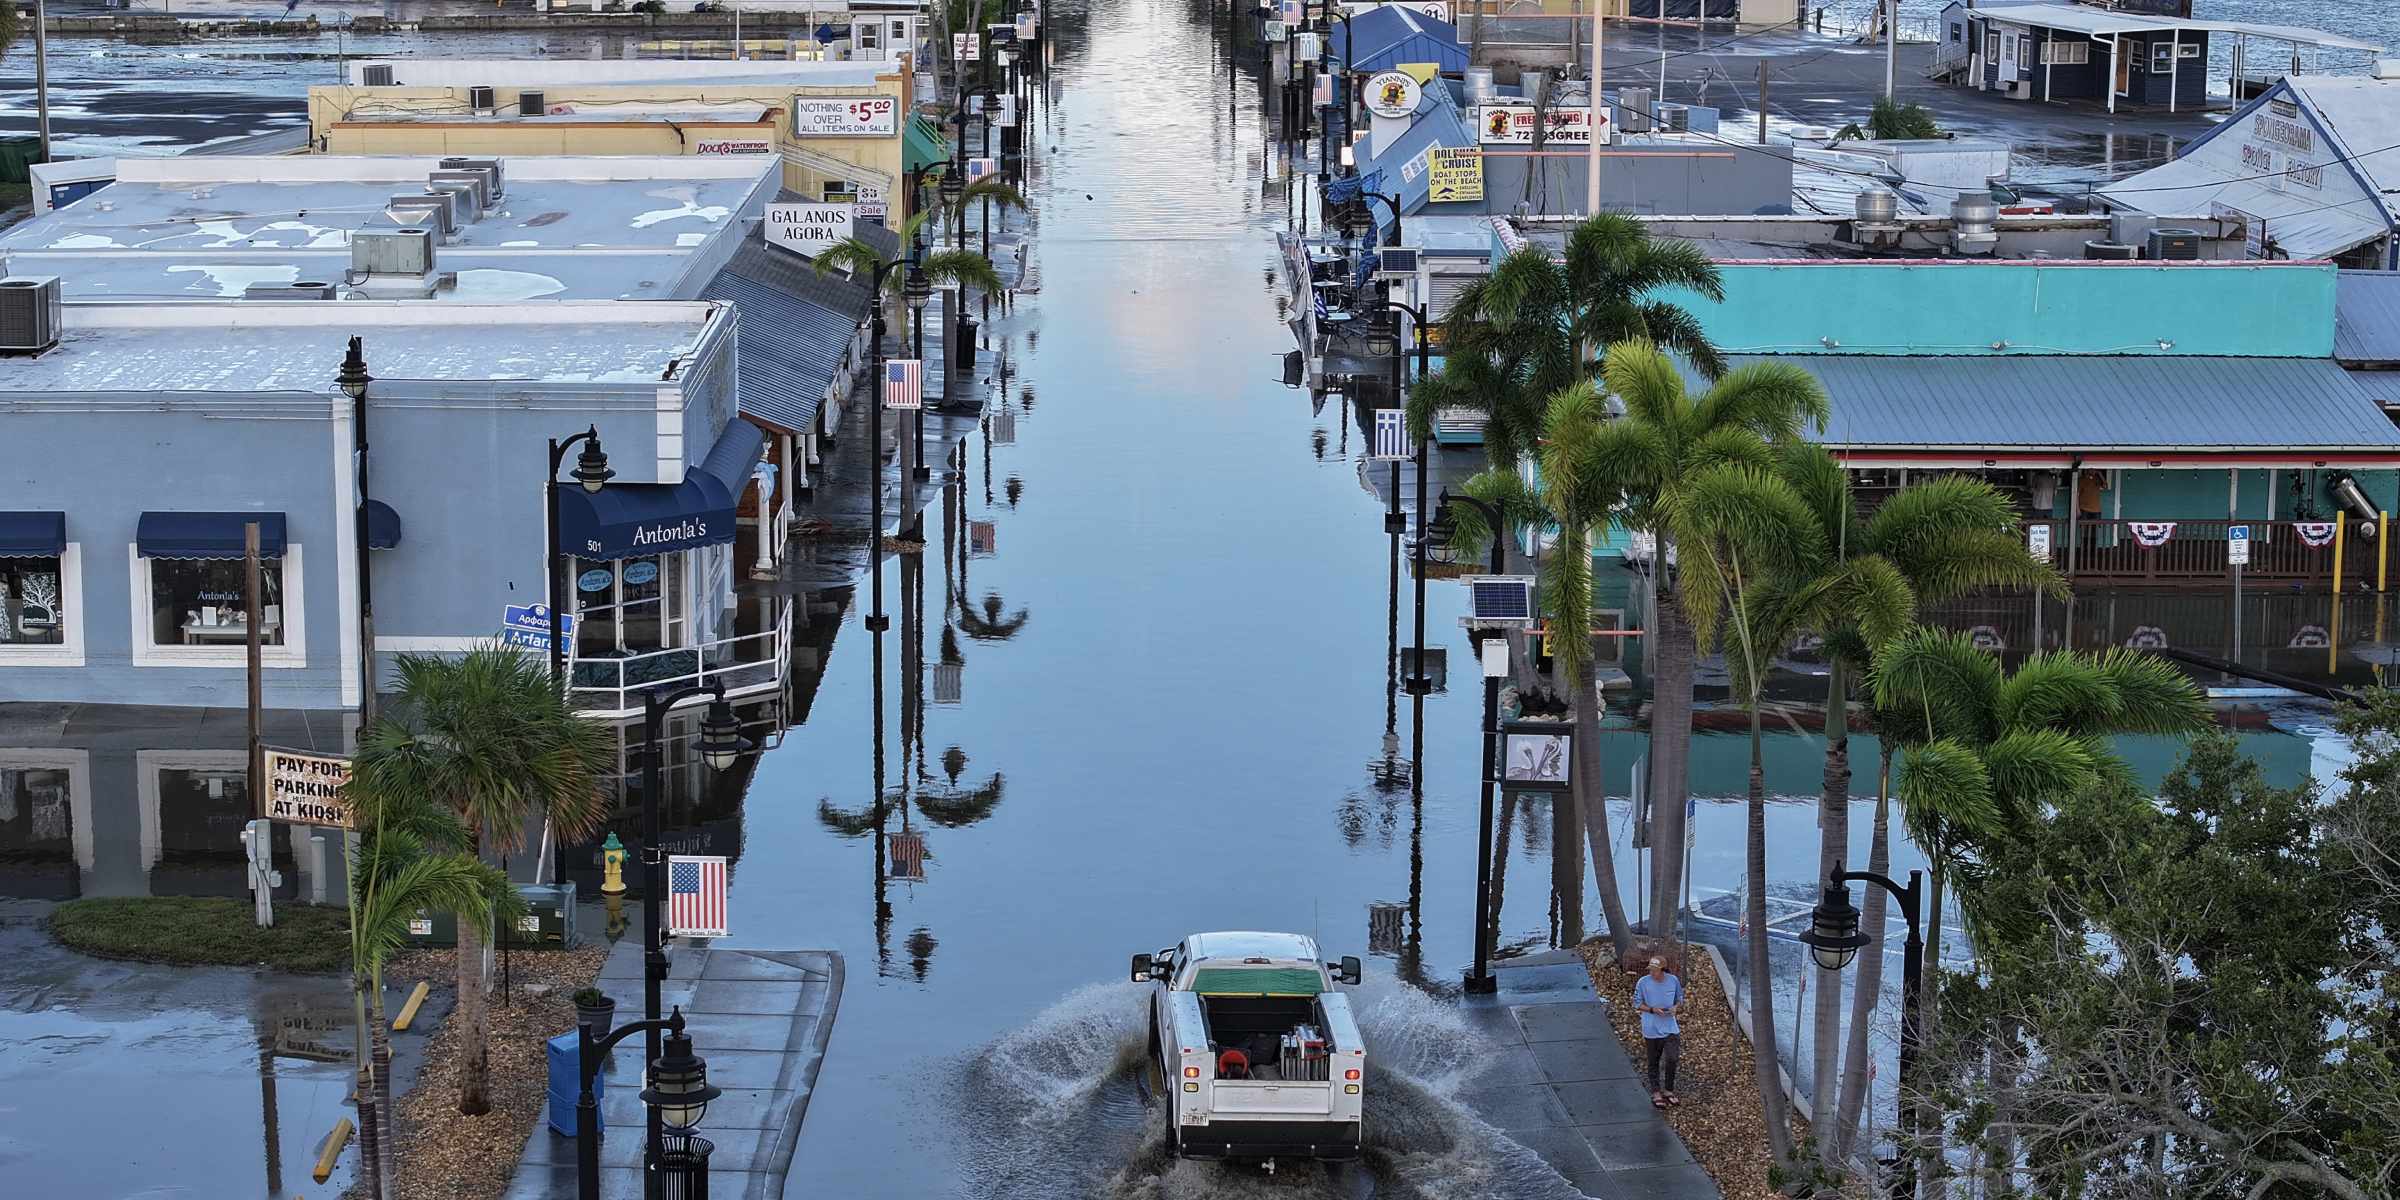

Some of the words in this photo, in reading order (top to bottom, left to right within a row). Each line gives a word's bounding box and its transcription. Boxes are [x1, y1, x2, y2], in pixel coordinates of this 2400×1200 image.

[1376, 76, 1411, 87] YIANNI'S
[800, 103, 842, 113] NOTHING
[813, 114, 843, 124] OVER
[823, 124, 852, 132] ITEMS
[869, 124, 890, 132] SALE
[2254, 113, 2312, 152] SPONGEORAMA
[1442, 159, 1477, 169] CRUISE
[2242, 143, 2271, 171] SPONGE
[2286, 156, 2320, 186] FACTORY
[1455, 170, 1478, 178] STOPS
[1461, 177, 1482, 185] BEACH
[860, 205, 882, 214] Sale
[772, 210, 846, 223] GALANOS
[783, 227, 835, 240] AGORA
[633, 517, 707, 546] Antonia's
[587, 539, 602, 552] 501
[197, 590, 239, 601] Antonia's
[276, 757, 306, 772] PAY
[311, 761, 341, 777] FOR
[292, 795, 306, 803] HUT
[273, 800, 292, 815] AT
